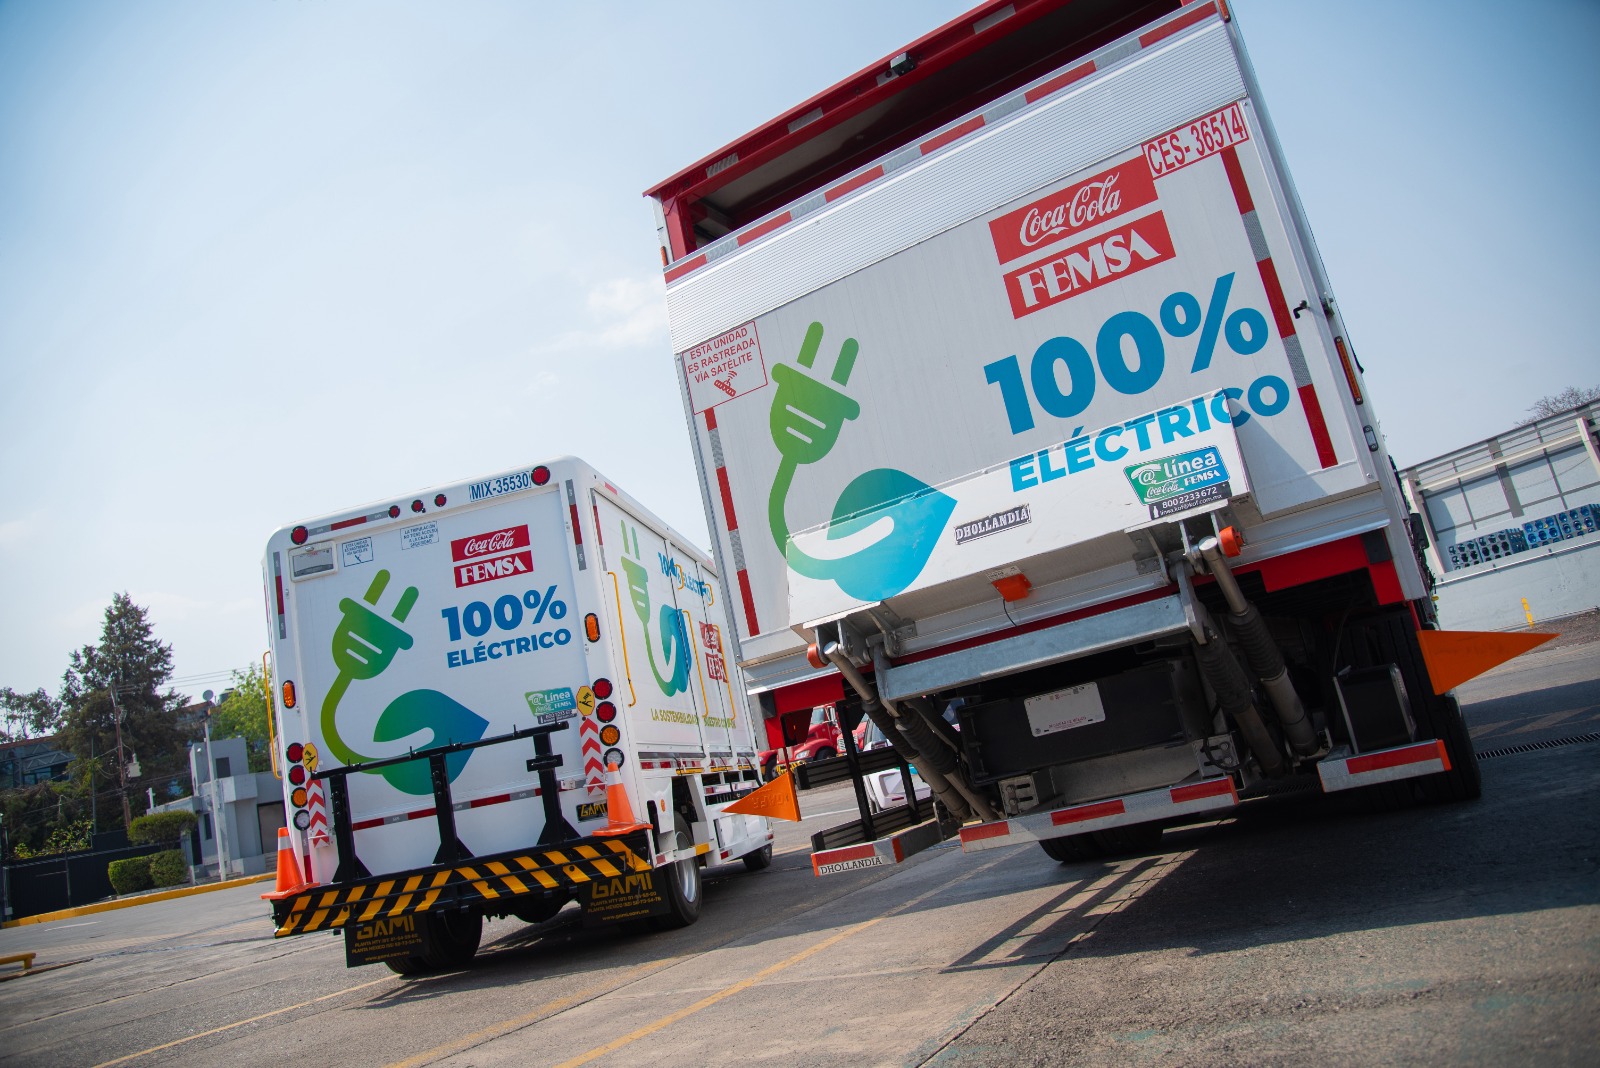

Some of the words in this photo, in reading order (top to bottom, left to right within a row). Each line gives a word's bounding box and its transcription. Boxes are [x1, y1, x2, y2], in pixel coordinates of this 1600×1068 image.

[1190, 107, 1244, 157] 36514
[1016, 228, 1162, 309] FEMSA
[687, 362, 700, 374] ES
[701, 337, 756, 368] RASTREADA
[690, 343, 713, 360] ESTA
[713, 327, 748, 349] UNIDAD
[983, 271, 1269, 436] 100%
[694, 370, 710, 384] VÍA
[711, 351, 753, 377] SATÉLITE
[1009, 374, 1290, 493] ELÉCTRICO
[1163, 451, 1217, 478] línea
[1183, 469, 1222, 486] FEMSA
[471, 472, 529, 500] MIX-35530
[956, 507, 1029, 541] DHOLLANDIA
[460, 555, 528, 585] FEMSA
[441, 584, 568, 642] 100%
[446, 628, 572, 669] ELÉCTRICO
[544, 691, 571, 703] Línea
[820, 856, 883, 875] DHOLLANDIA
[591, 872, 653, 899] GAMI
[356, 914, 415, 940] GAMI
